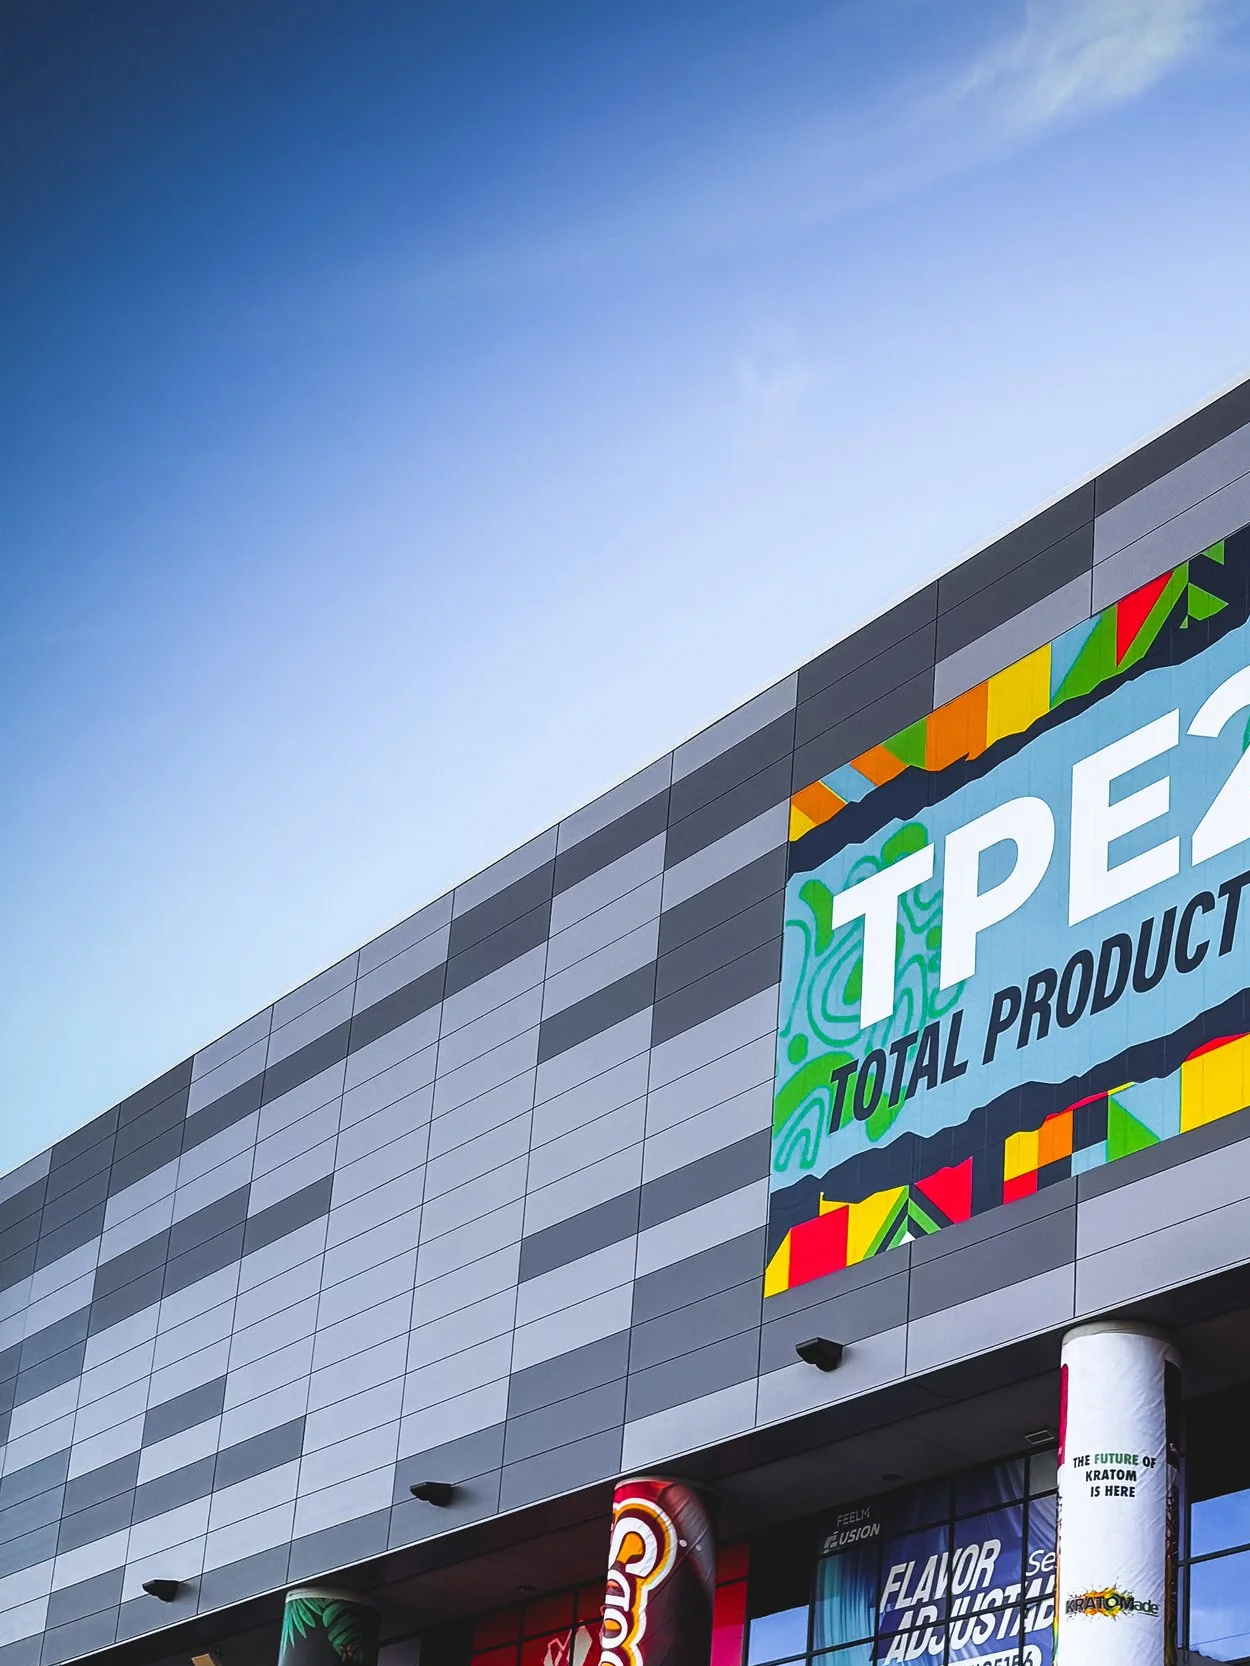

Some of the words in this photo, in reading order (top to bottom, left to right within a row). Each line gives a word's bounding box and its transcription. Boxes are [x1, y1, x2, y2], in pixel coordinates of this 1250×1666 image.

[827, 1027, 971, 1133] TOTAL
[1073, 1455, 1090, 1468] THE
[1094, 1453, 1139, 1465] FUTURE
[1143, 1457, 1156, 1468] OF
[1085, 1470, 1137, 1482] KRATOM
[1090, 1486, 1100, 1498] IS
[1105, 1485, 1136, 1498] HERE
[837, 1507, 870, 1526] FEELM
[879, 1539, 1002, 1614] FLAVOR
